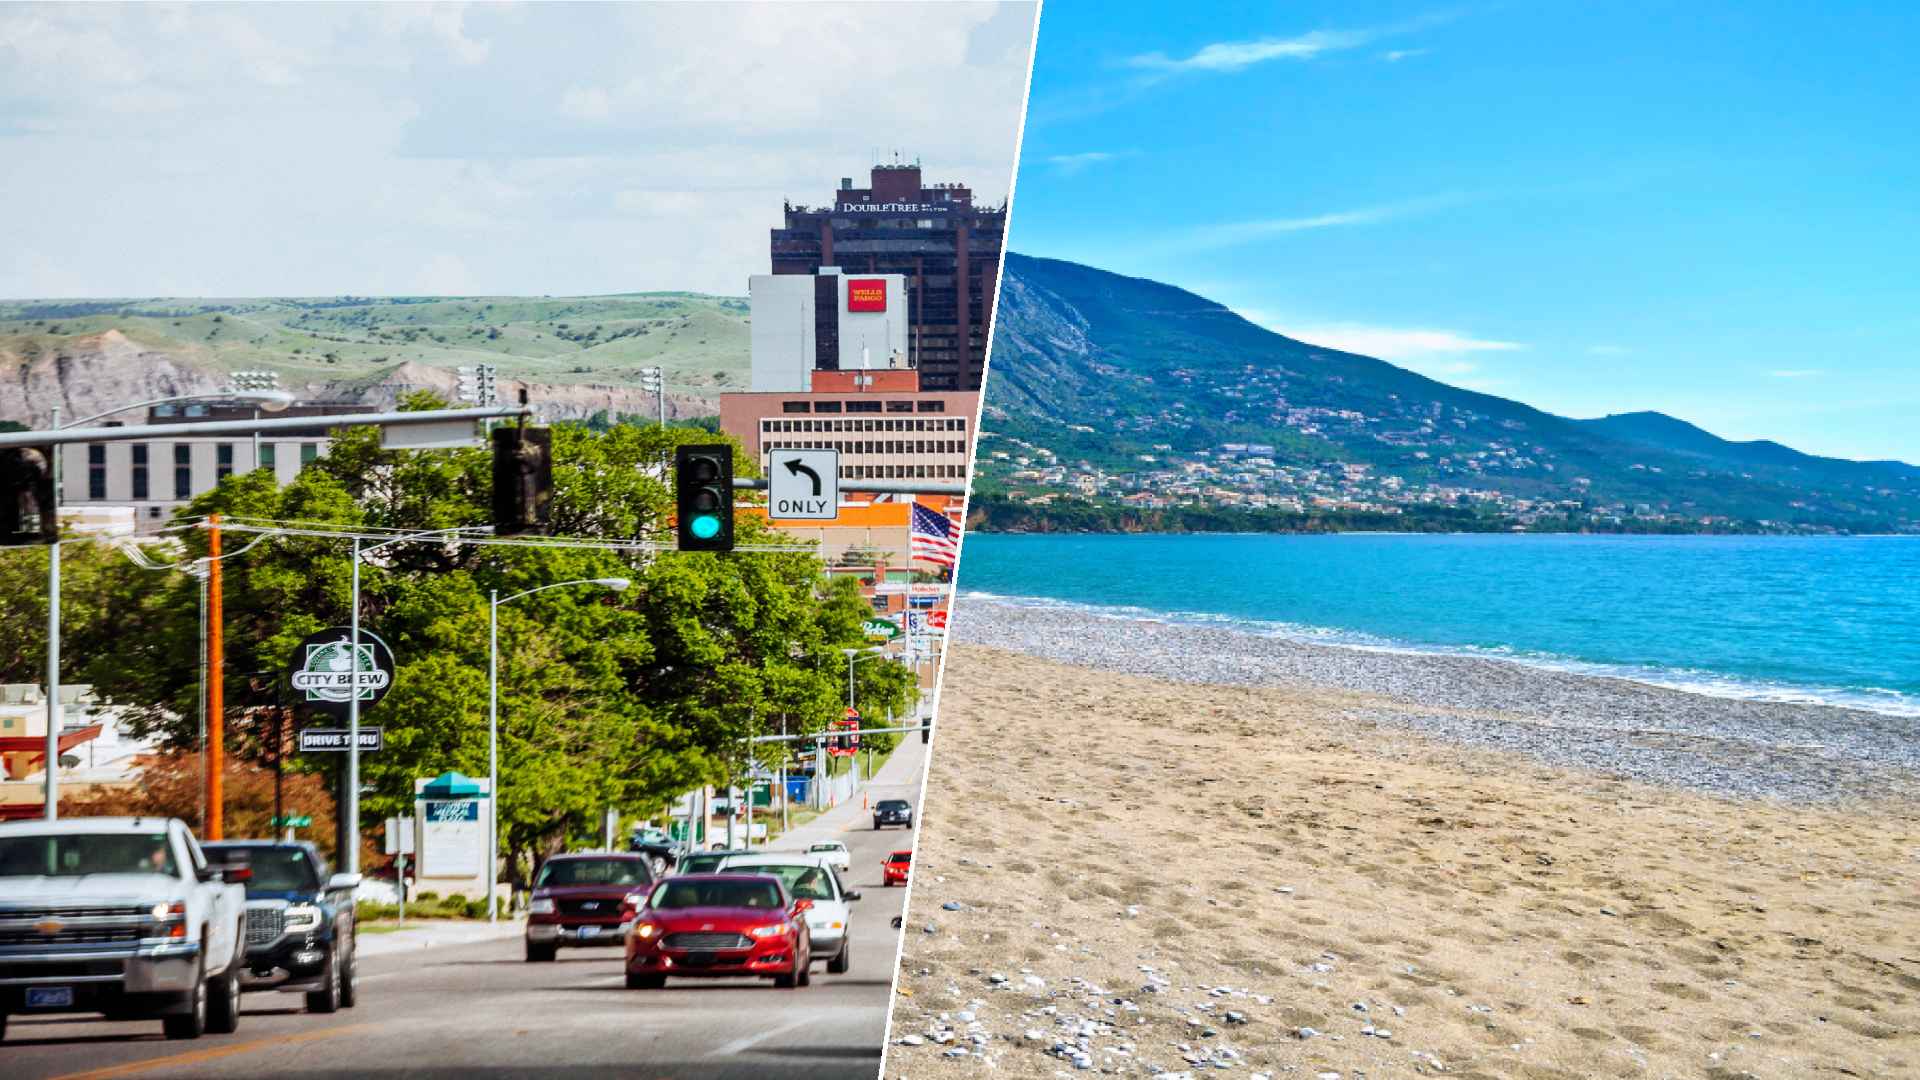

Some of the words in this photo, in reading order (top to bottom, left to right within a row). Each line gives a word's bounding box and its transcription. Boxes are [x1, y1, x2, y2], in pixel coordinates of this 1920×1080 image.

[843, 203, 919, 212] DOUBLETREE
[778, 500, 827, 513] ONLY
[297, 674, 330, 685] CITY
[304, 734, 341, 746] DRIVE
[343, 734, 377, 745] TRU
